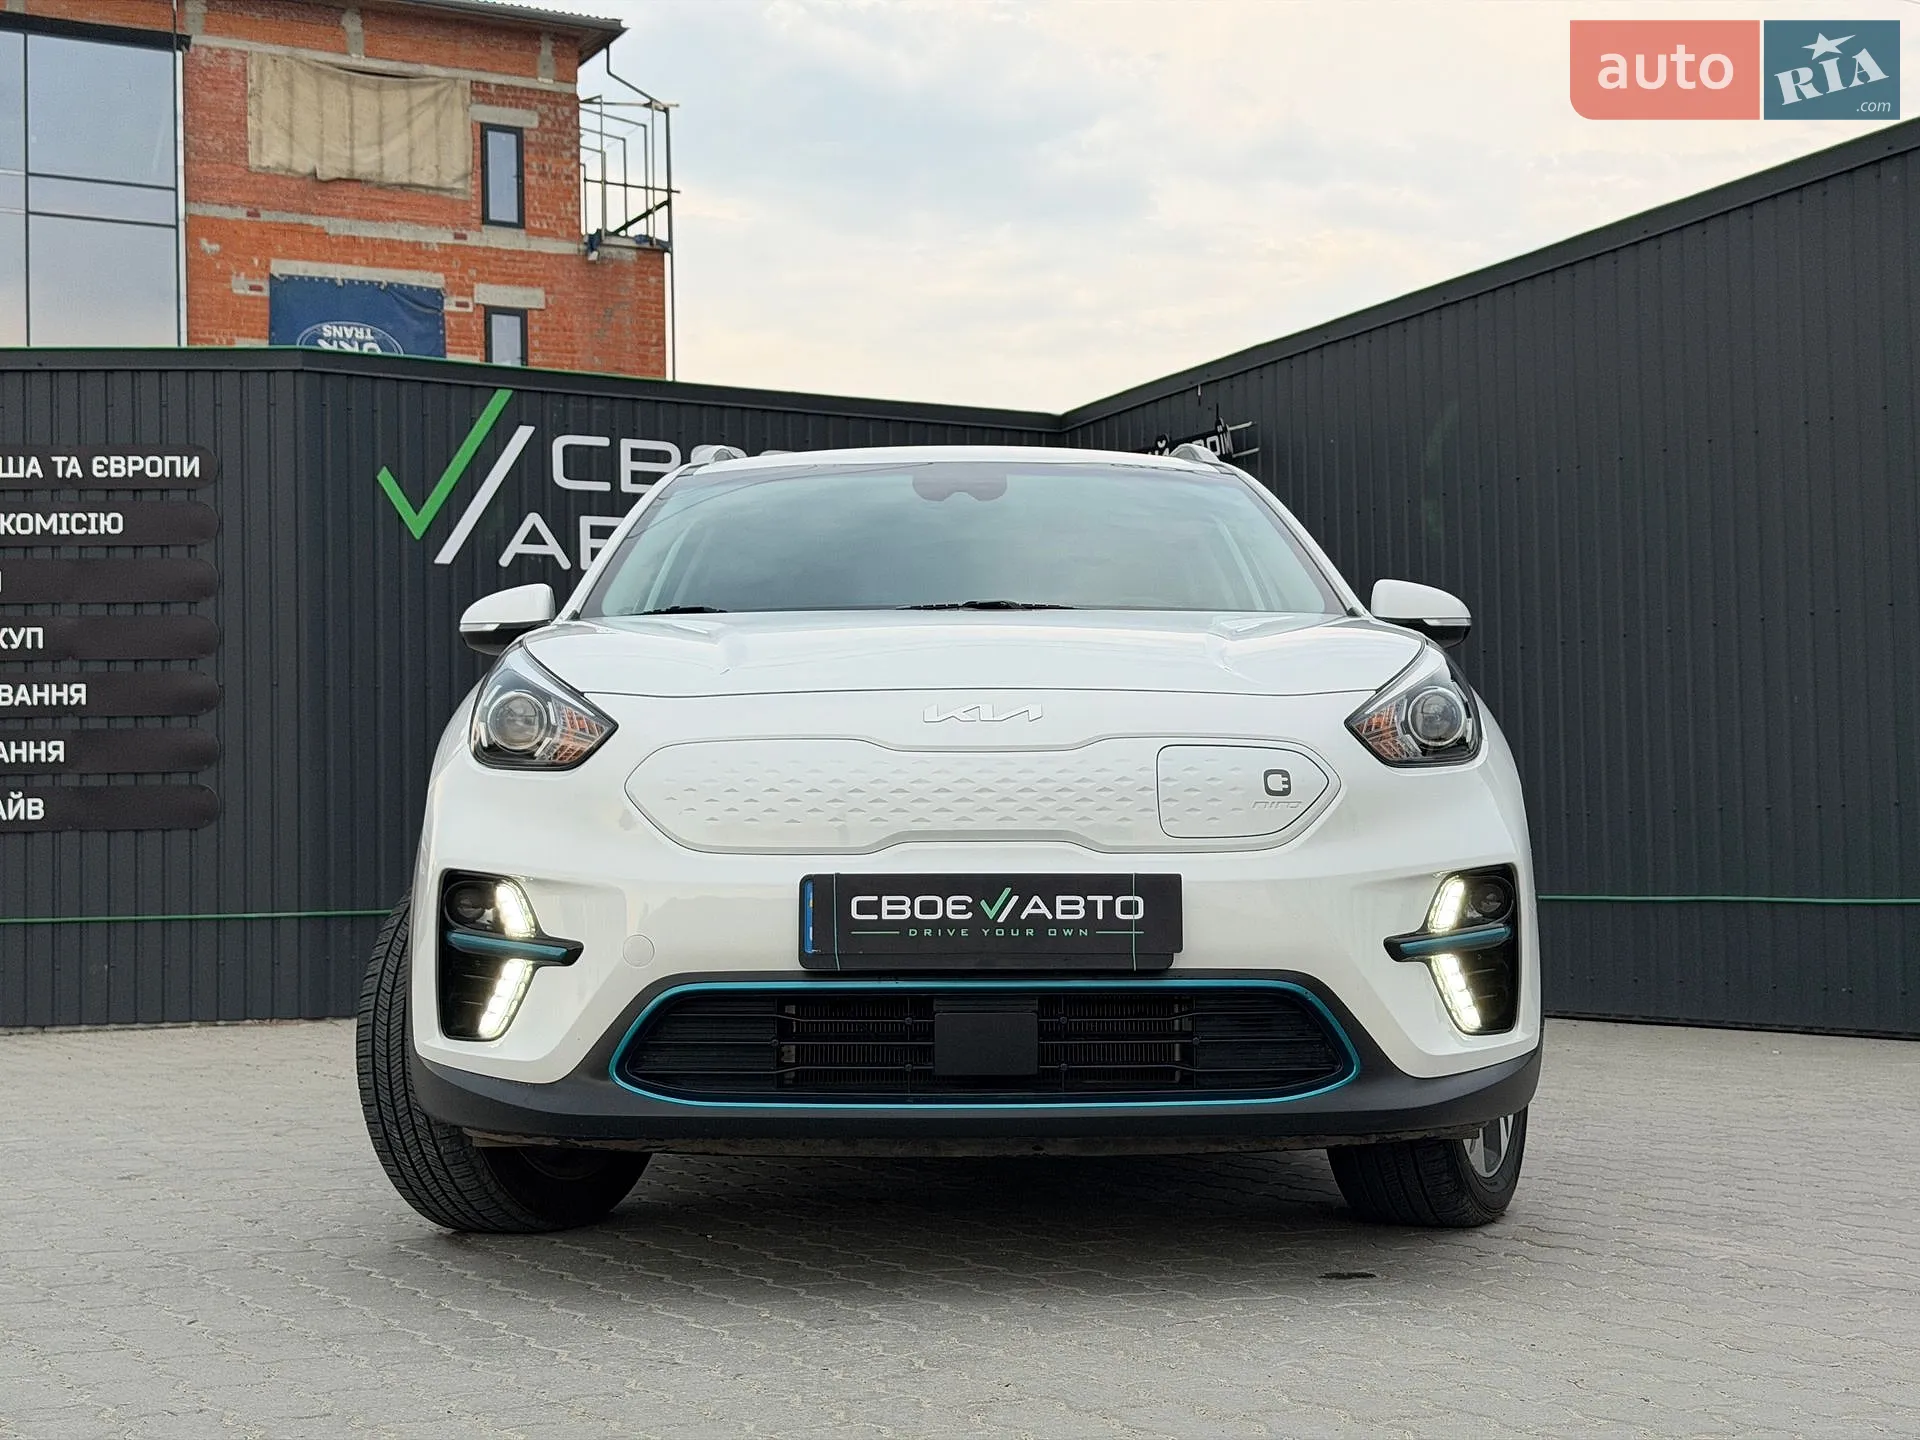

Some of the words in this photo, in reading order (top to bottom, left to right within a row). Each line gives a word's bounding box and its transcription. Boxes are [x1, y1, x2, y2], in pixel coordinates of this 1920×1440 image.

[322, 325, 374, 340] TRANS
[52, 456, 83, 478] ТА
[92, 456, 200, 478] ЄВРОПИ
[0, 512, 124, 535] КОМІСІЮ
[923, 703, 1043, 723] KIA
[1020, 895, 1144, 920] АВТО
[908, 928, 969, 937] DRIVE
[981, 928, 1034, 937] YOUR
[1048, 928, 1089, 937] OWN
